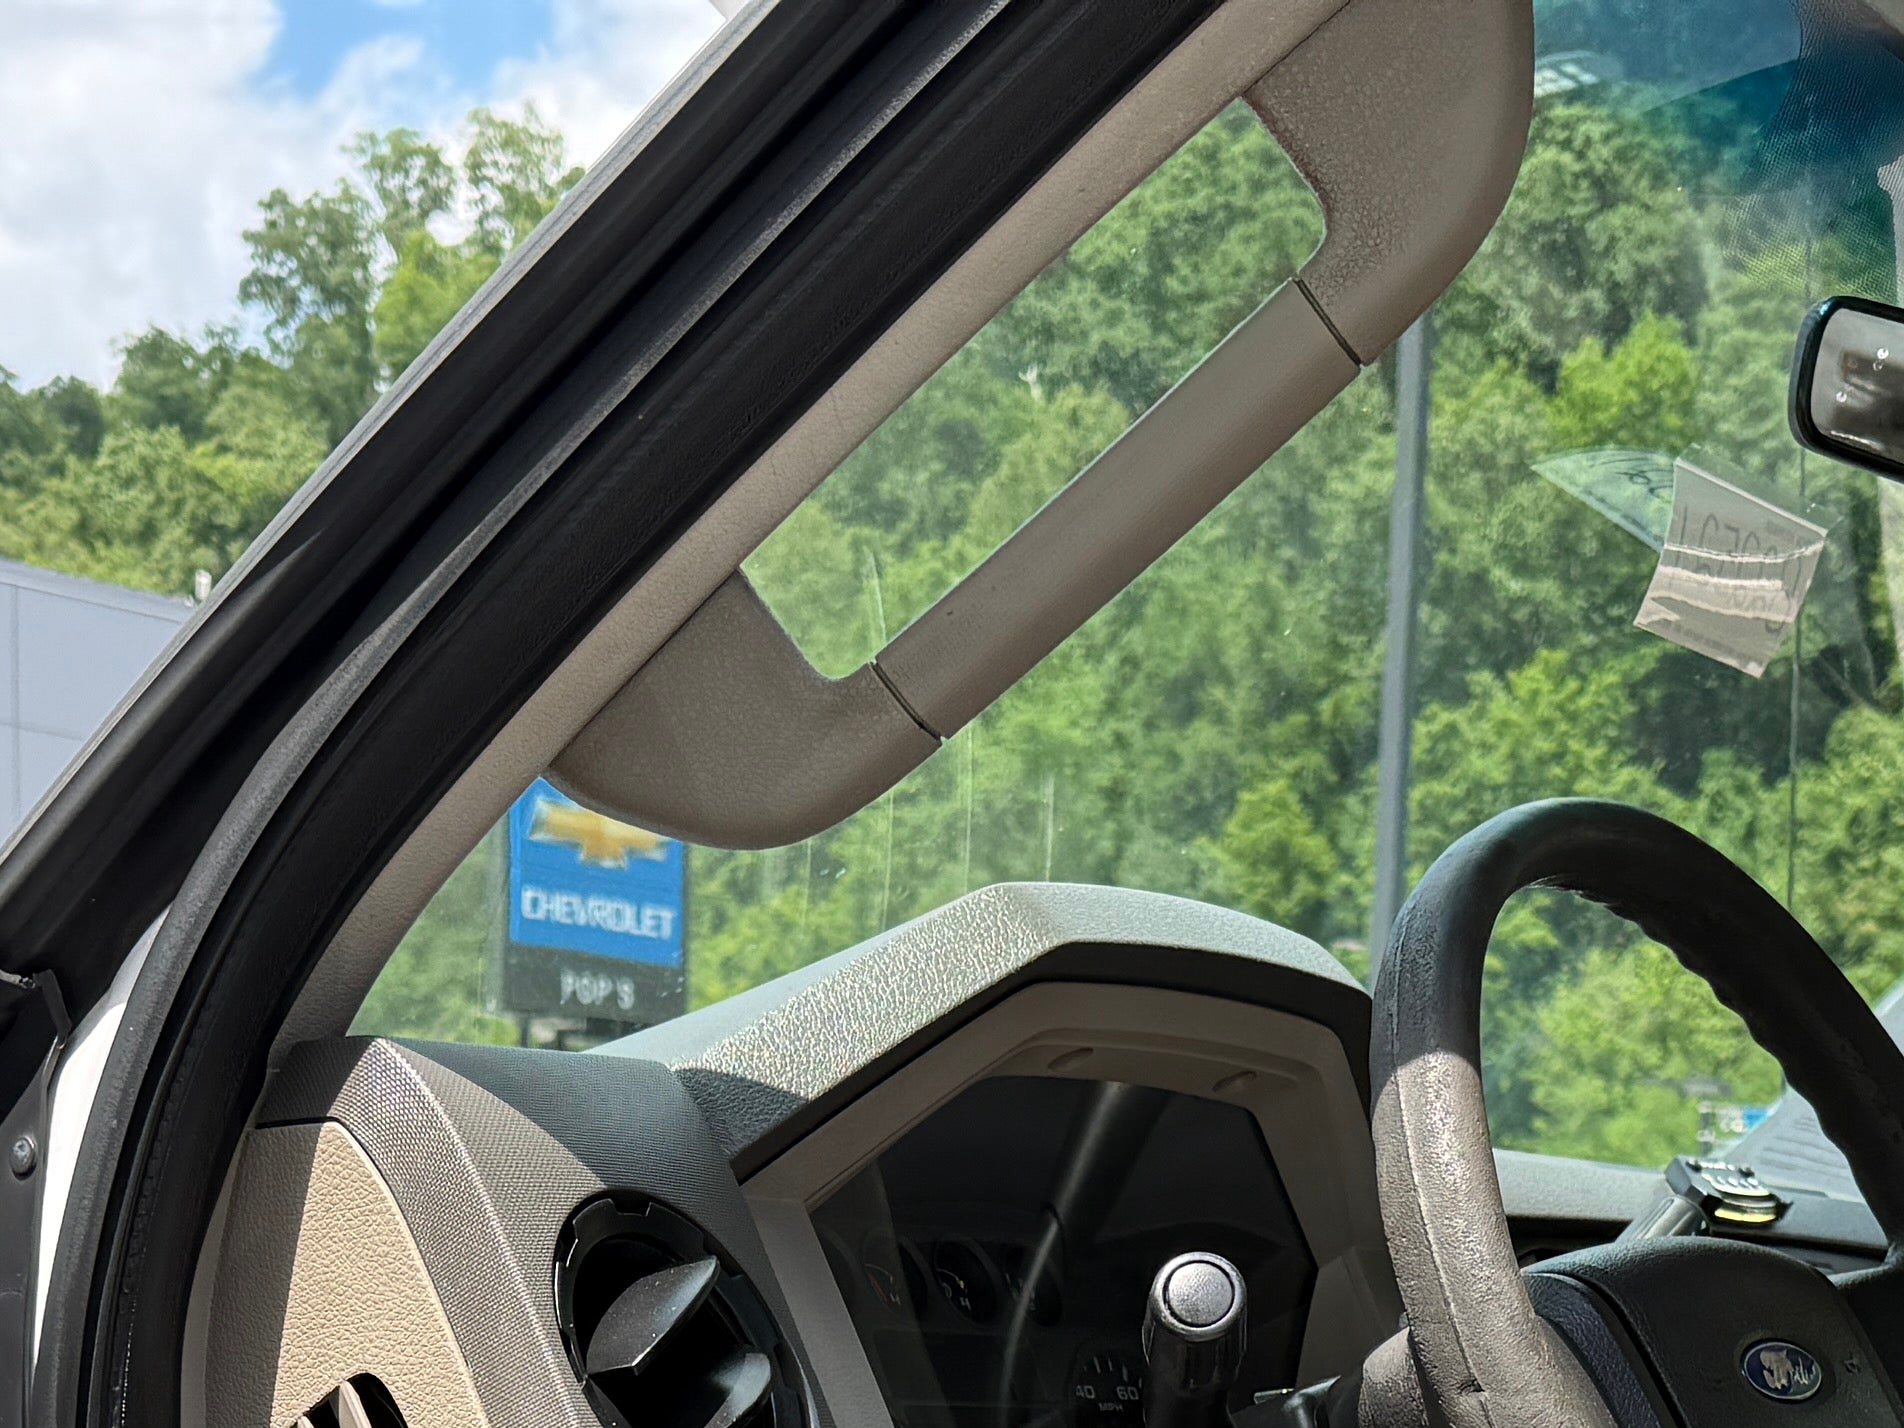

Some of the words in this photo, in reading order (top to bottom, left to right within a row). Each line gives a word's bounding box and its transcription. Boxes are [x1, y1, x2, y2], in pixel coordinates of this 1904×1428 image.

[521, 886, 674, 940] CHEVROLET
[1075, 1385, 1095, 1400] 40
[1116, 1386, 1140, 1400] 60
[1097, 1402, 1124, 1412] MPH
